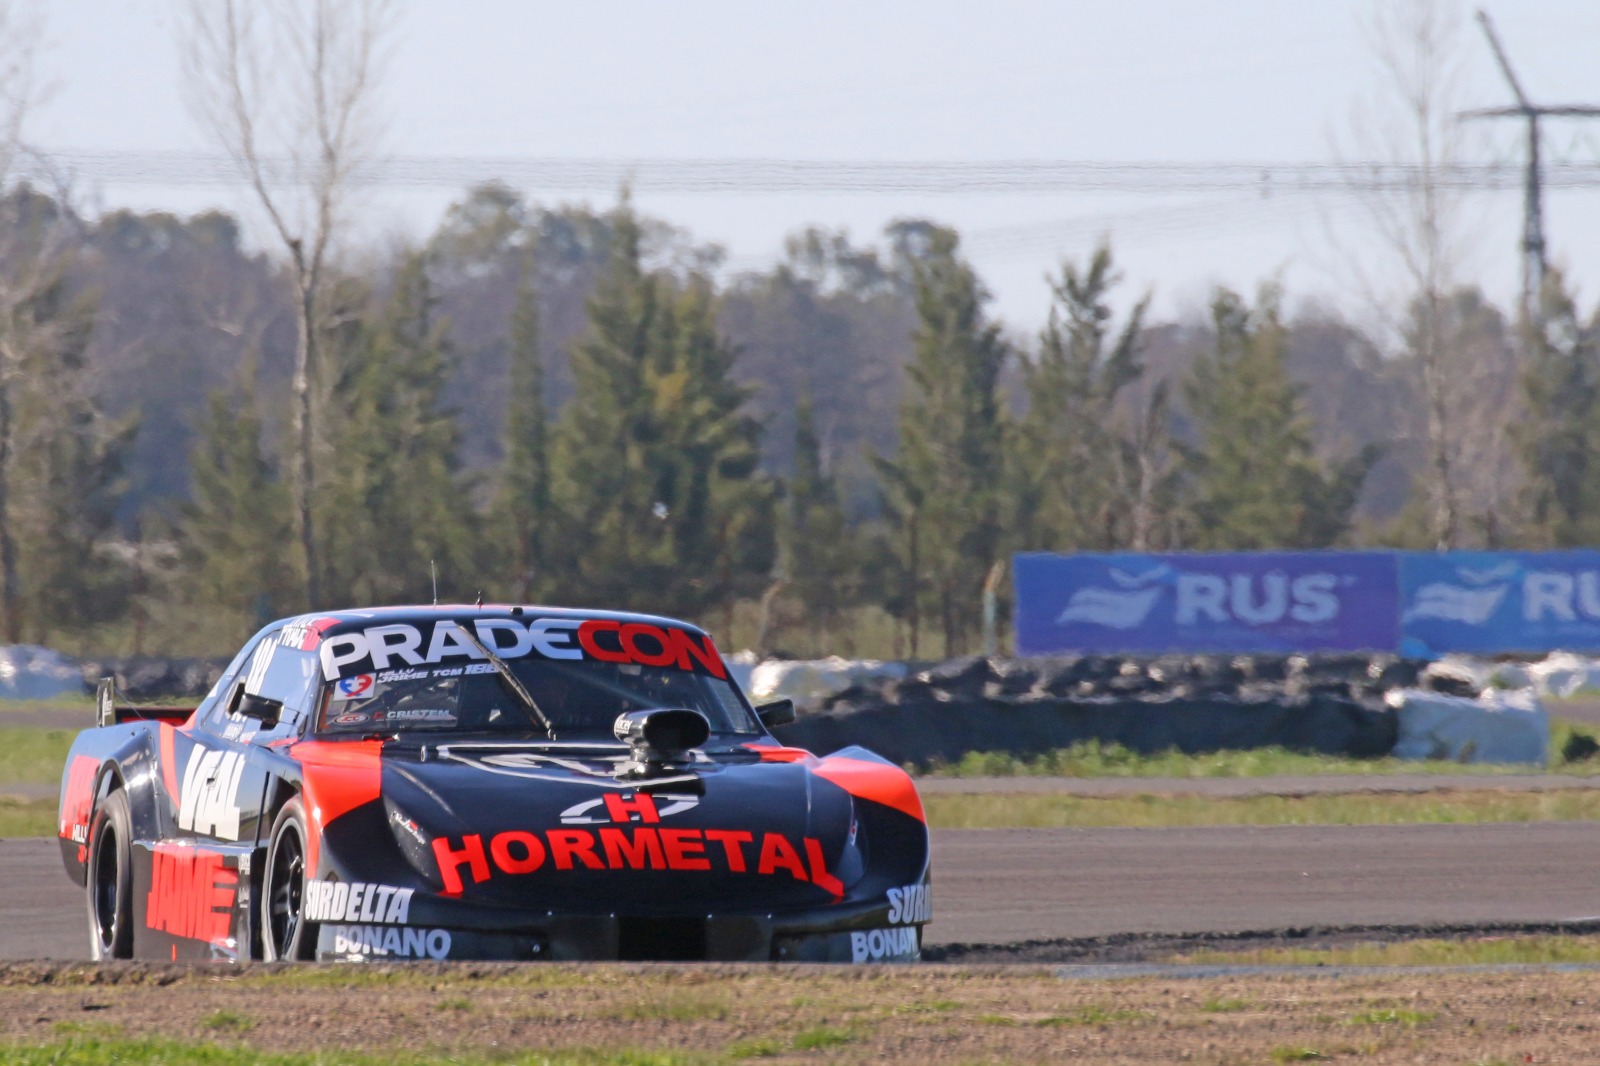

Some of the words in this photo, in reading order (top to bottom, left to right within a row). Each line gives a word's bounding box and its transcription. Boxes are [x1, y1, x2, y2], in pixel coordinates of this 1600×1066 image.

[1175, 571, 1340, 625] RUS
[320, 618, 728, 681] PRADECON
[433, 668, 463, 677] TCM
[432, 828, 844, 896] HORMETAL
[147, 845, 238, 939] JAIME
[305, 880, 415, 924] SURDELTA
[335, 925, 451, 960] BONANO
